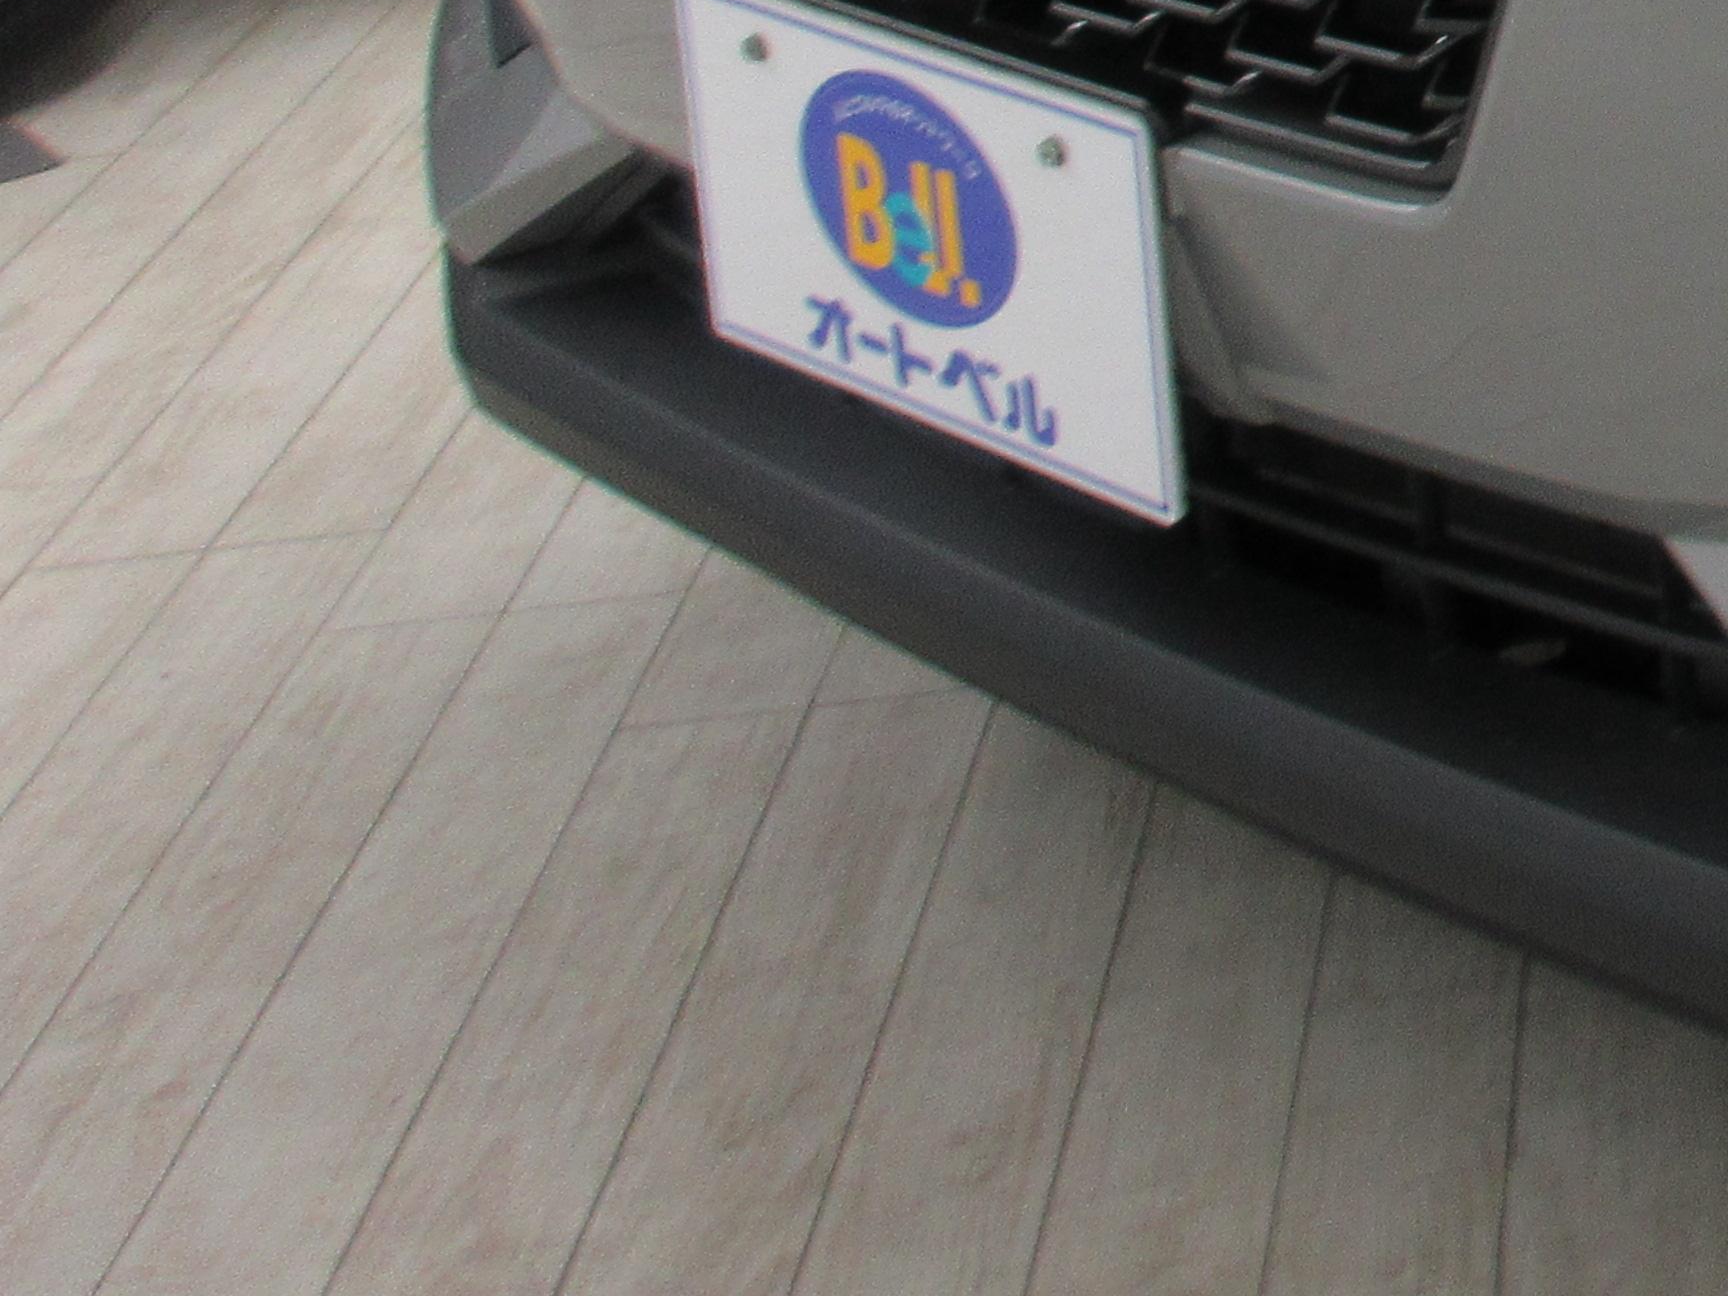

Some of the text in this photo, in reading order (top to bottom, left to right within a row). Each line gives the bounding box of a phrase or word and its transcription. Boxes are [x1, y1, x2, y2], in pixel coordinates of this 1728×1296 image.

[804, 294, 1059, 449] オートベル
